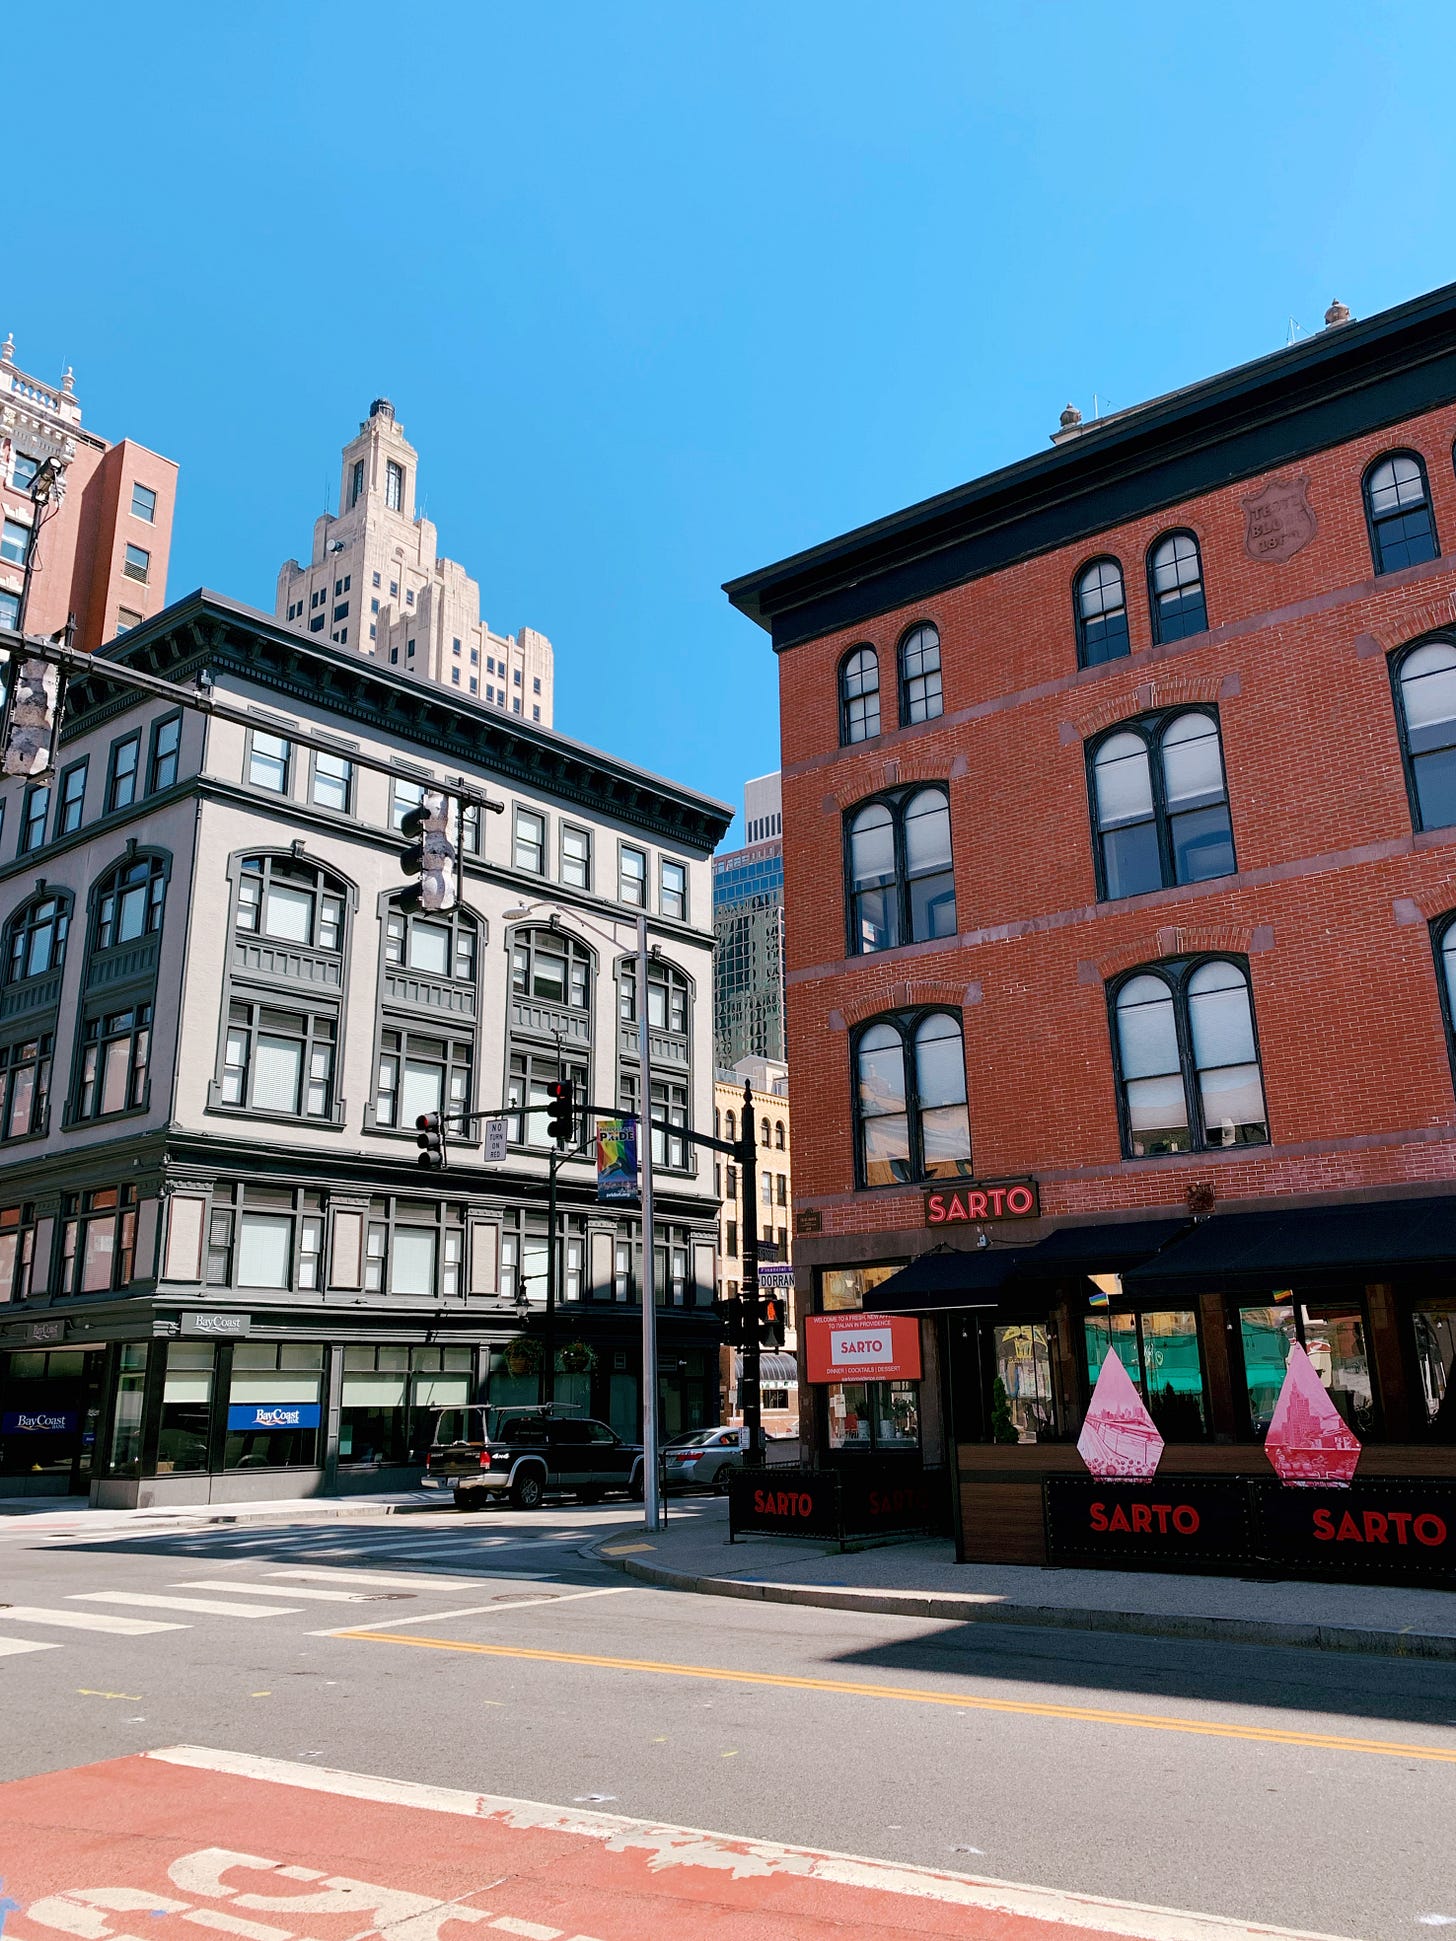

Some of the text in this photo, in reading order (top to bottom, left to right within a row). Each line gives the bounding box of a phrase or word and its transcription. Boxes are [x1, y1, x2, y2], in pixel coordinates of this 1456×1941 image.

[491, 1123, 502, 1131] NO
[600, 1131, 634, 1141] PRIDE
[928, 1185, 1034, 1222] SARTO
[196, 1315, 240, 1328] BayCoast
[841, 1340, 882, 1353] SARTO
[18, 1415, 66, 1428] BayCoast
[256, 1408, 299, 1422] BayCoast
[491, 1452, 510, 1460] 4x4
[754, 1489, 812, 1517] SARTO
[868, 1488, 930, 1515] SARTO
[1089, 1501, 1200, 1535] SARTO
[1312, 1508, 1447, 1547] SARTO
